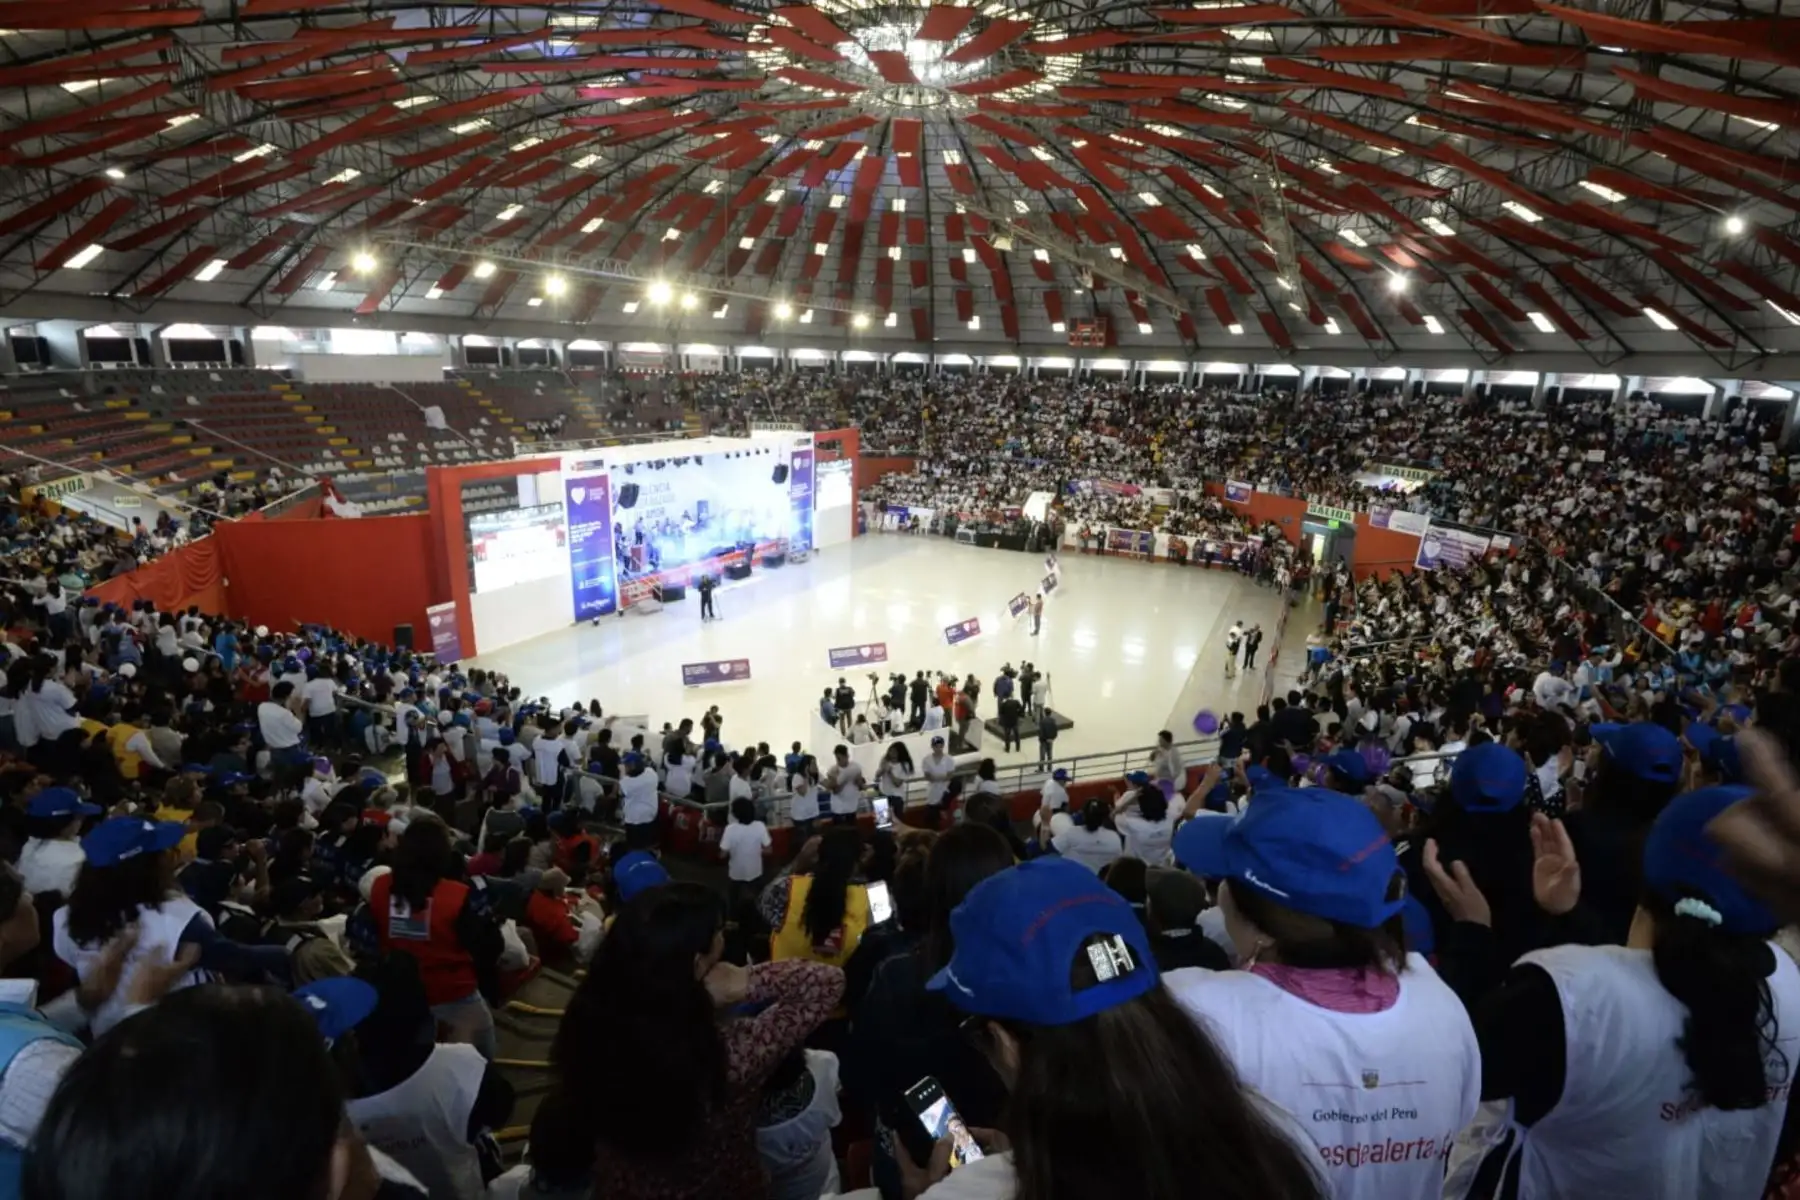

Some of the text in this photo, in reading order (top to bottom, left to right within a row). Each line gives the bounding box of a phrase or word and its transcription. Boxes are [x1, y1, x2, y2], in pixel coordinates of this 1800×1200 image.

[1383, 466, 1429, 480] SALIDA
[1309, 504, 1351, 520] SALIDA
[1313, 1108, 1368, 1124] Gobierno
[1371, 1108, 1388, 1122] del
